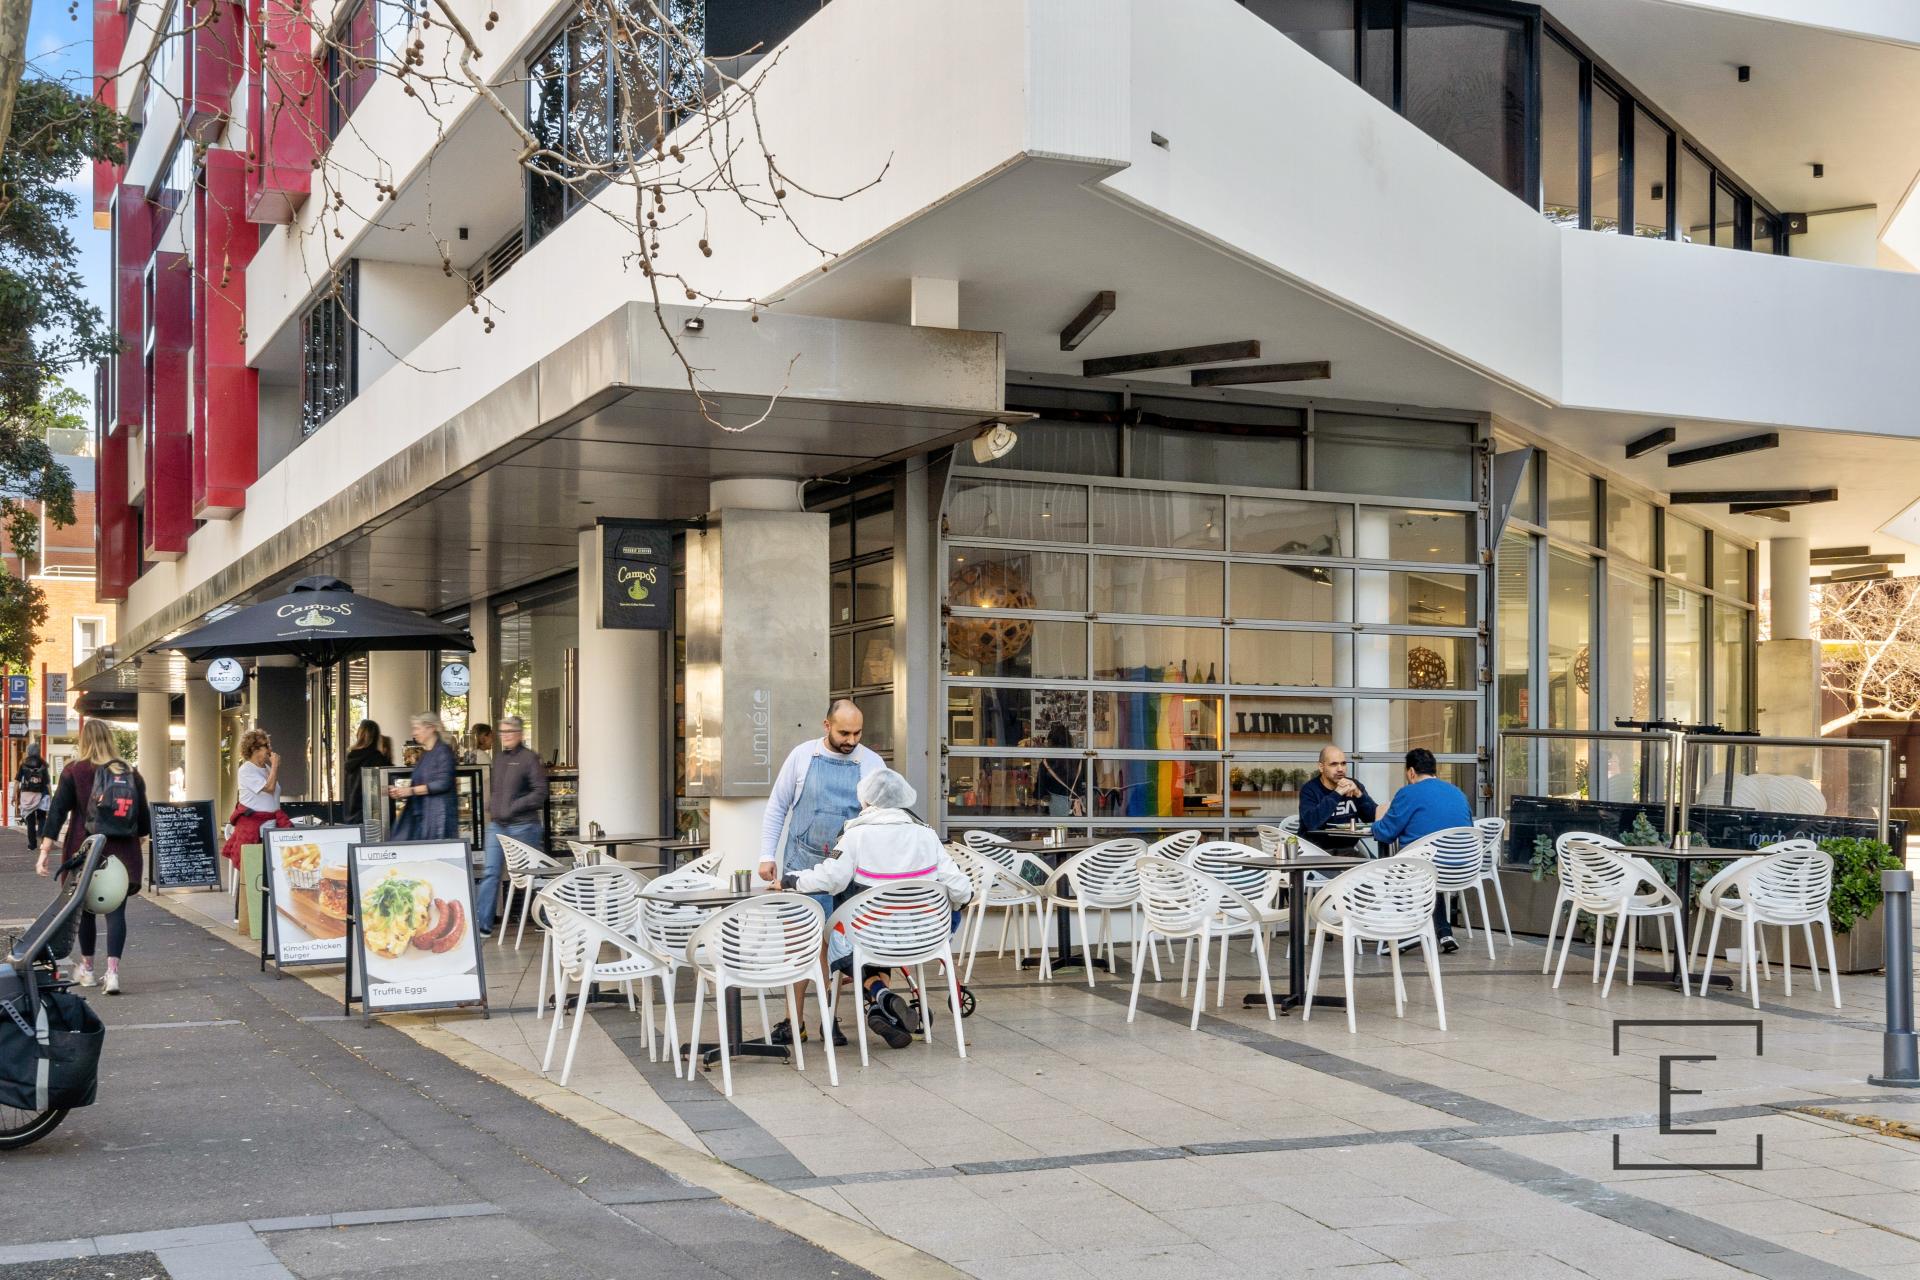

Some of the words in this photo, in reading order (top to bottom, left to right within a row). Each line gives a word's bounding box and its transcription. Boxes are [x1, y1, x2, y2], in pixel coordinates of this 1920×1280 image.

[14, 680, 24, 691] P
[372, 987, 402, 996] Truffle
[404, 986, 428, 995] Eggs
